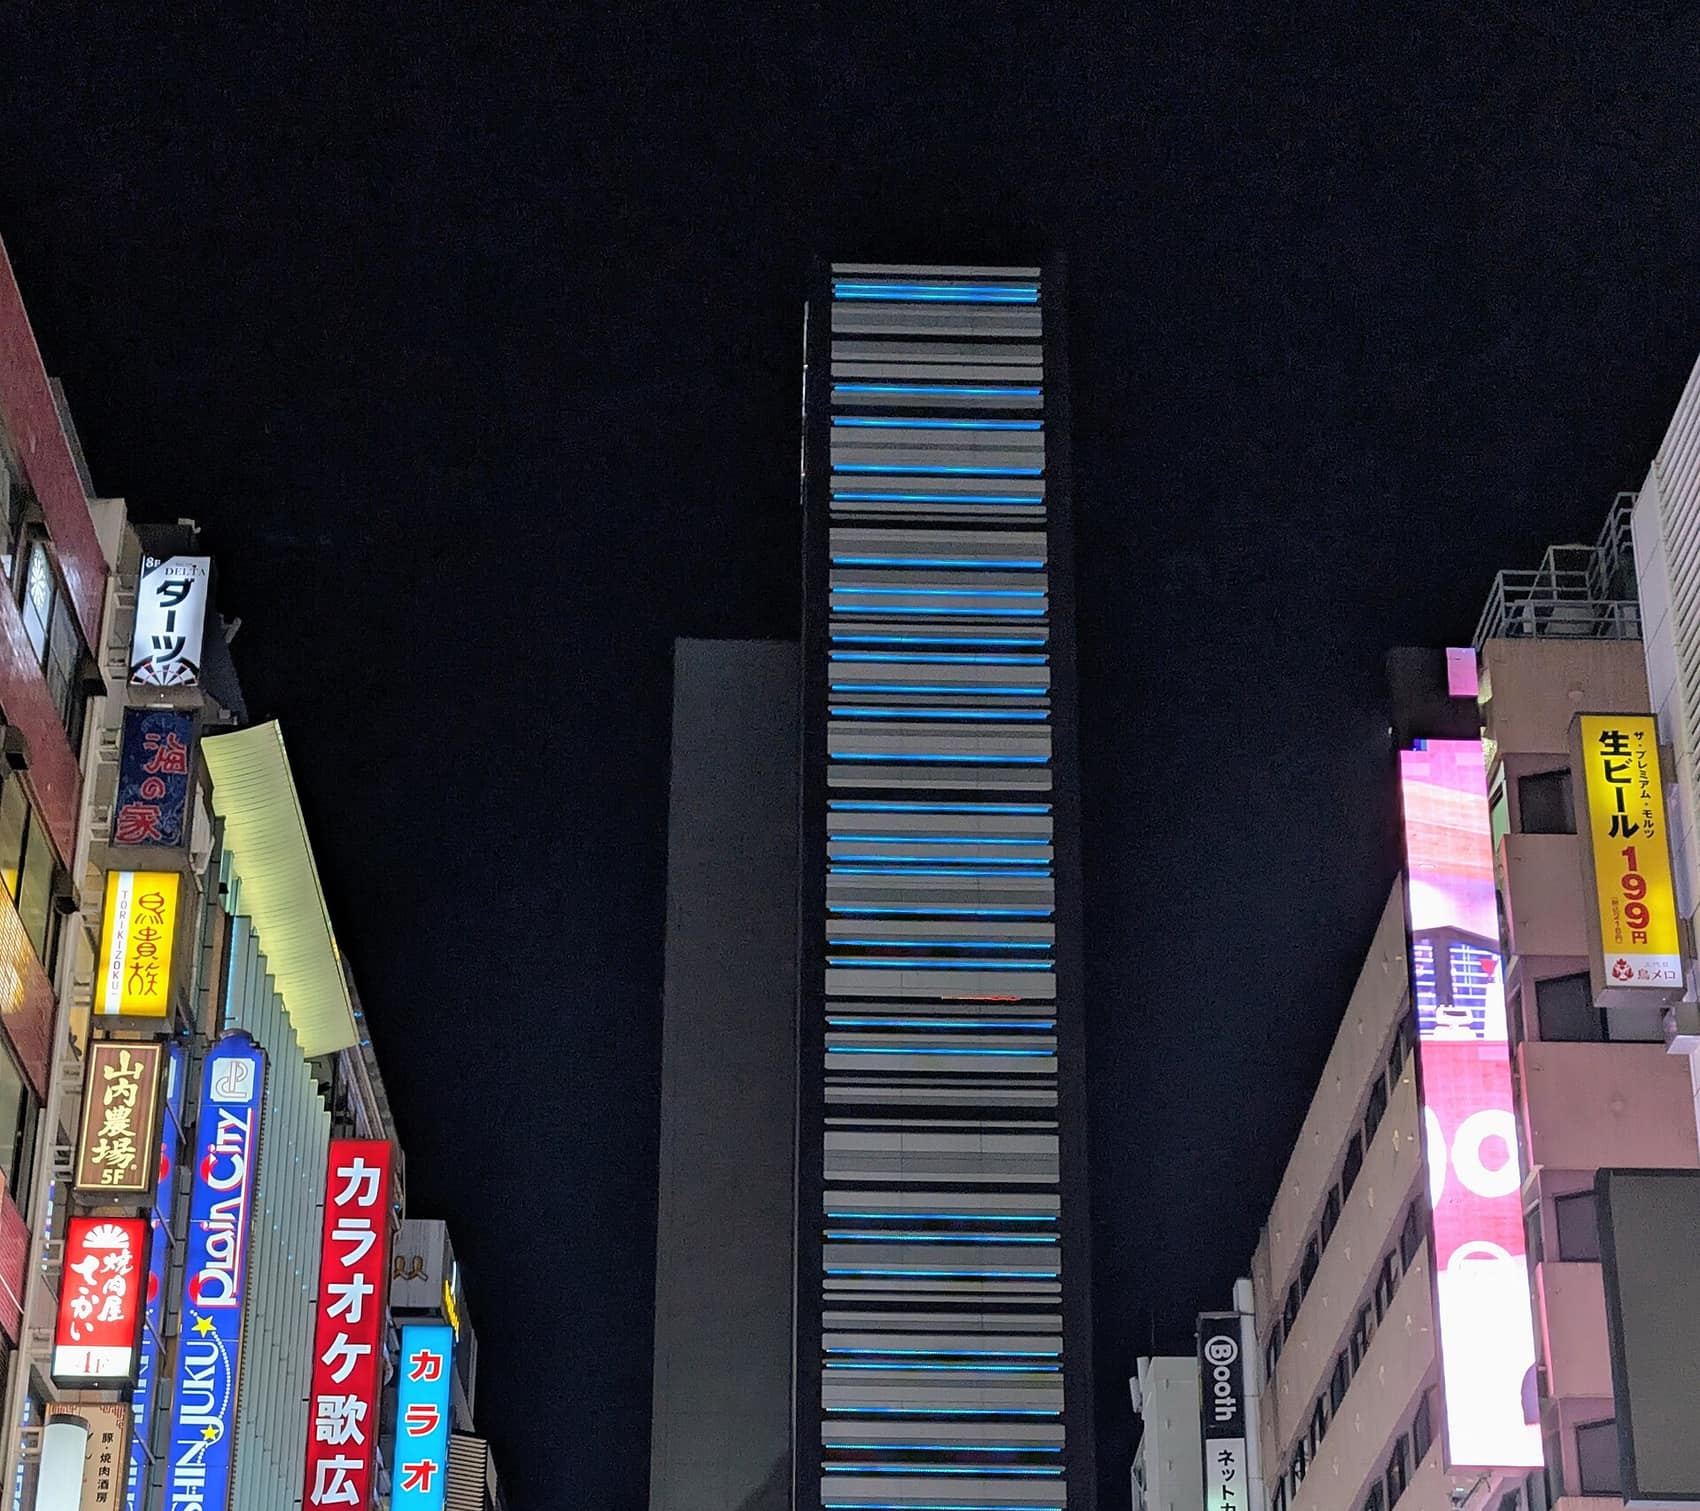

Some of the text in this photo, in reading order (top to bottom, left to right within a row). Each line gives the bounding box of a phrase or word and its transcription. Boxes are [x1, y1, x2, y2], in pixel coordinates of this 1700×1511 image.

[152, 578, 194, 664] ダーツ
[165, 565, 206, 577] DELTA
[116, 732, 188, 845] 海の家
[1599, 730, 1641, 840] 生ビール
[1633, 730, 1656, 840] ザ・プレミアム・モルツ
[128, 891, 168, 996] 鳥貴族
[1620, 846, 1651, 946] 199円
[91, 1050, 145, 1169] 山内農場
[101, 1168, 125, 1186] 5F
[98, 1248, 134, 1323] 焼肉屋
[1205, 1335, 1239, 1422] Booth
